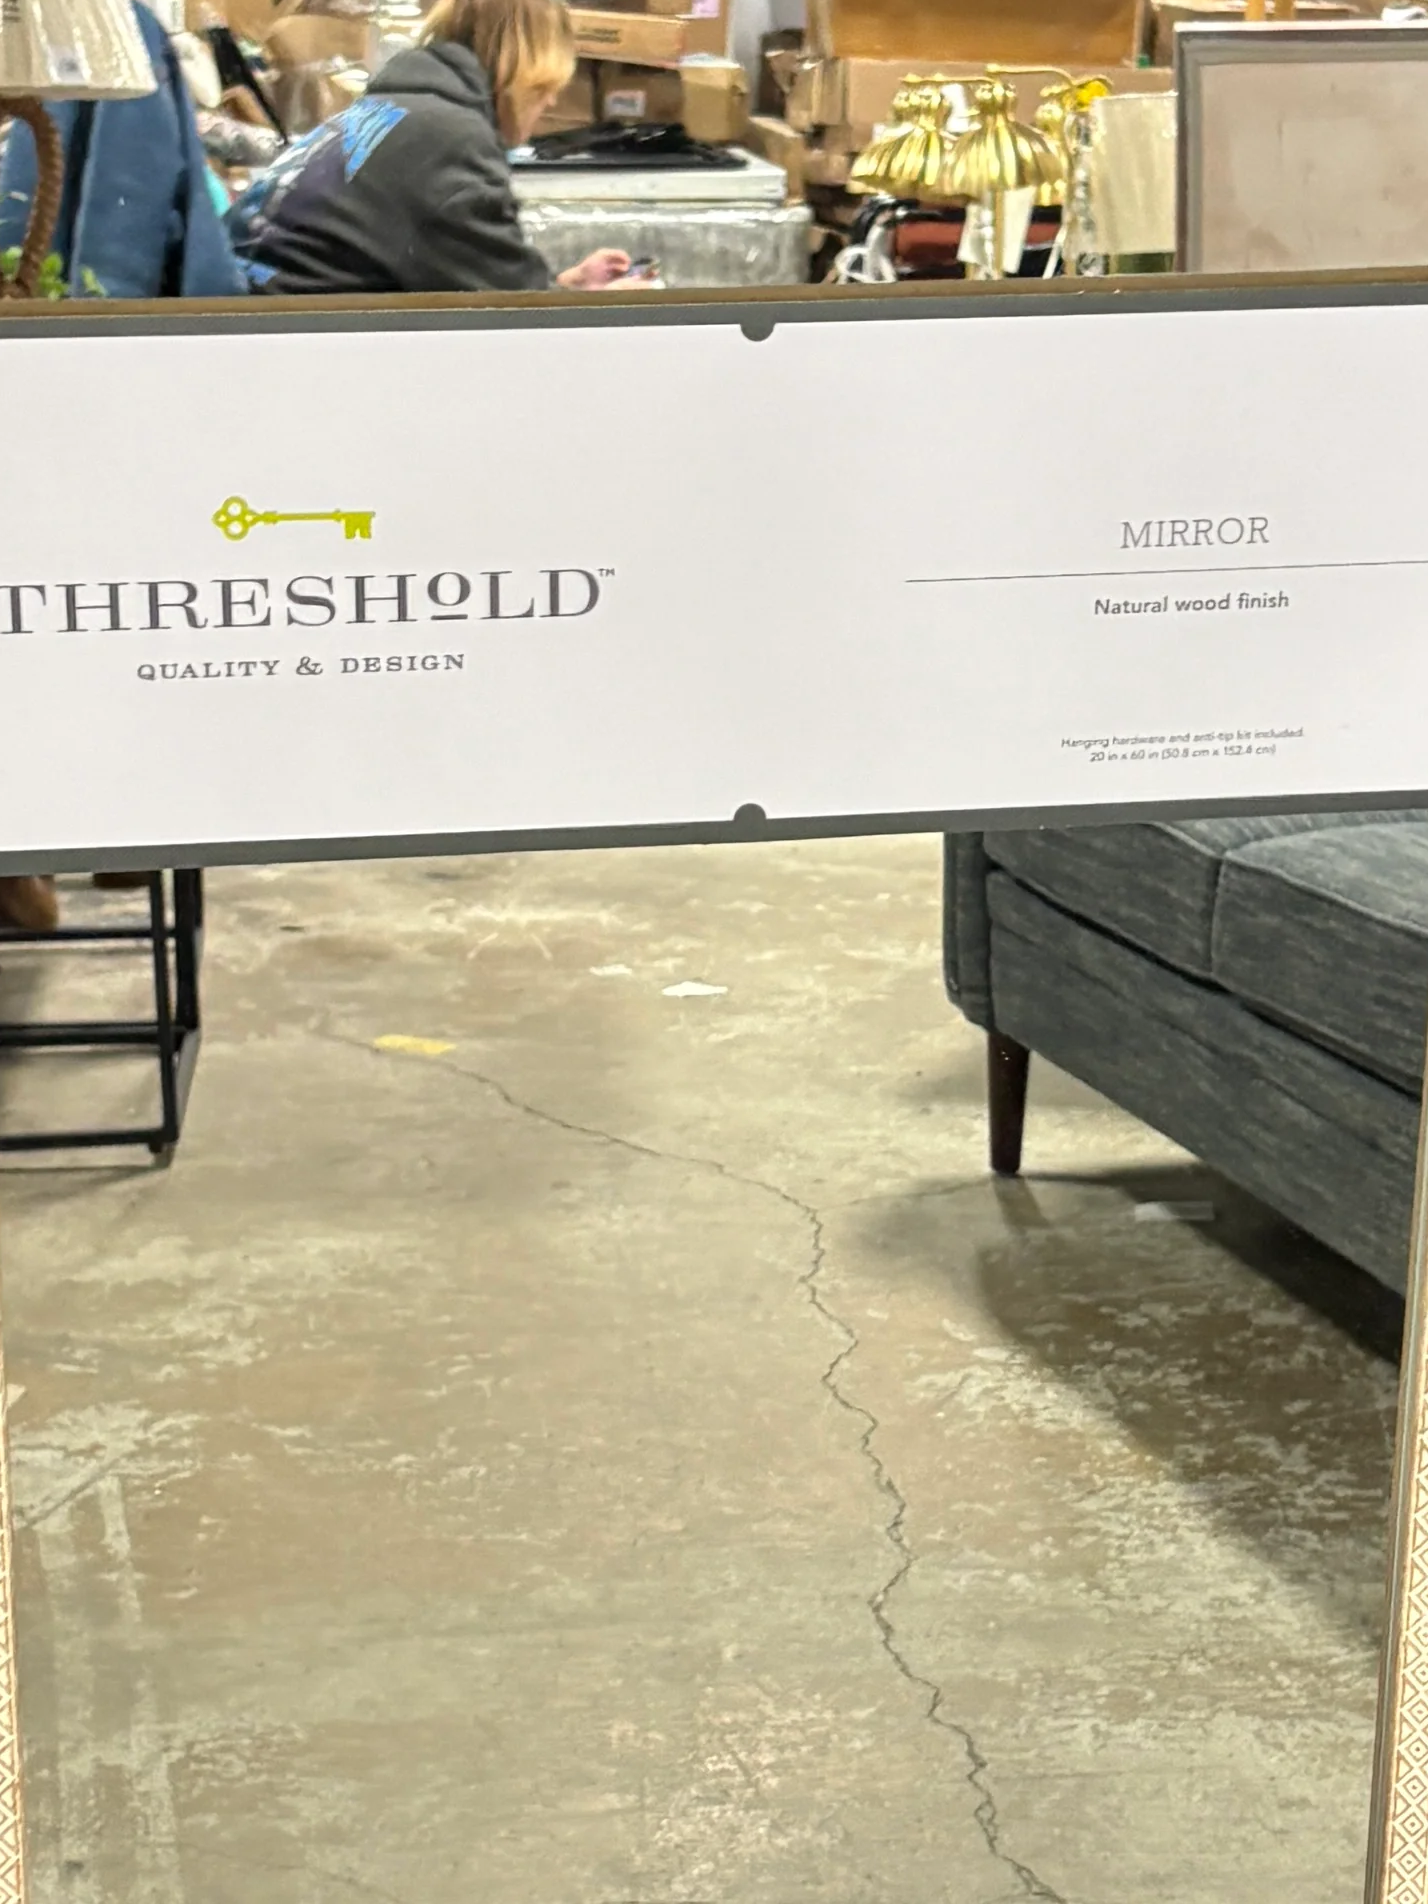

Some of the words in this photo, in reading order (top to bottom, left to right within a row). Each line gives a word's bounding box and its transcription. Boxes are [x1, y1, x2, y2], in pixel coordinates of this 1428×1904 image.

[1120, 517, 1271, 550] MIRROR
[1094, 595, 1169, 615] Natural
[1174, 592, 1232, 612] wood
[1236, 590, 1290, 609] finish
[136, 659, 281, 682] QUALITY
[295, 655, 324, 677] &
[339, 653, 466, 675] DESIGN
